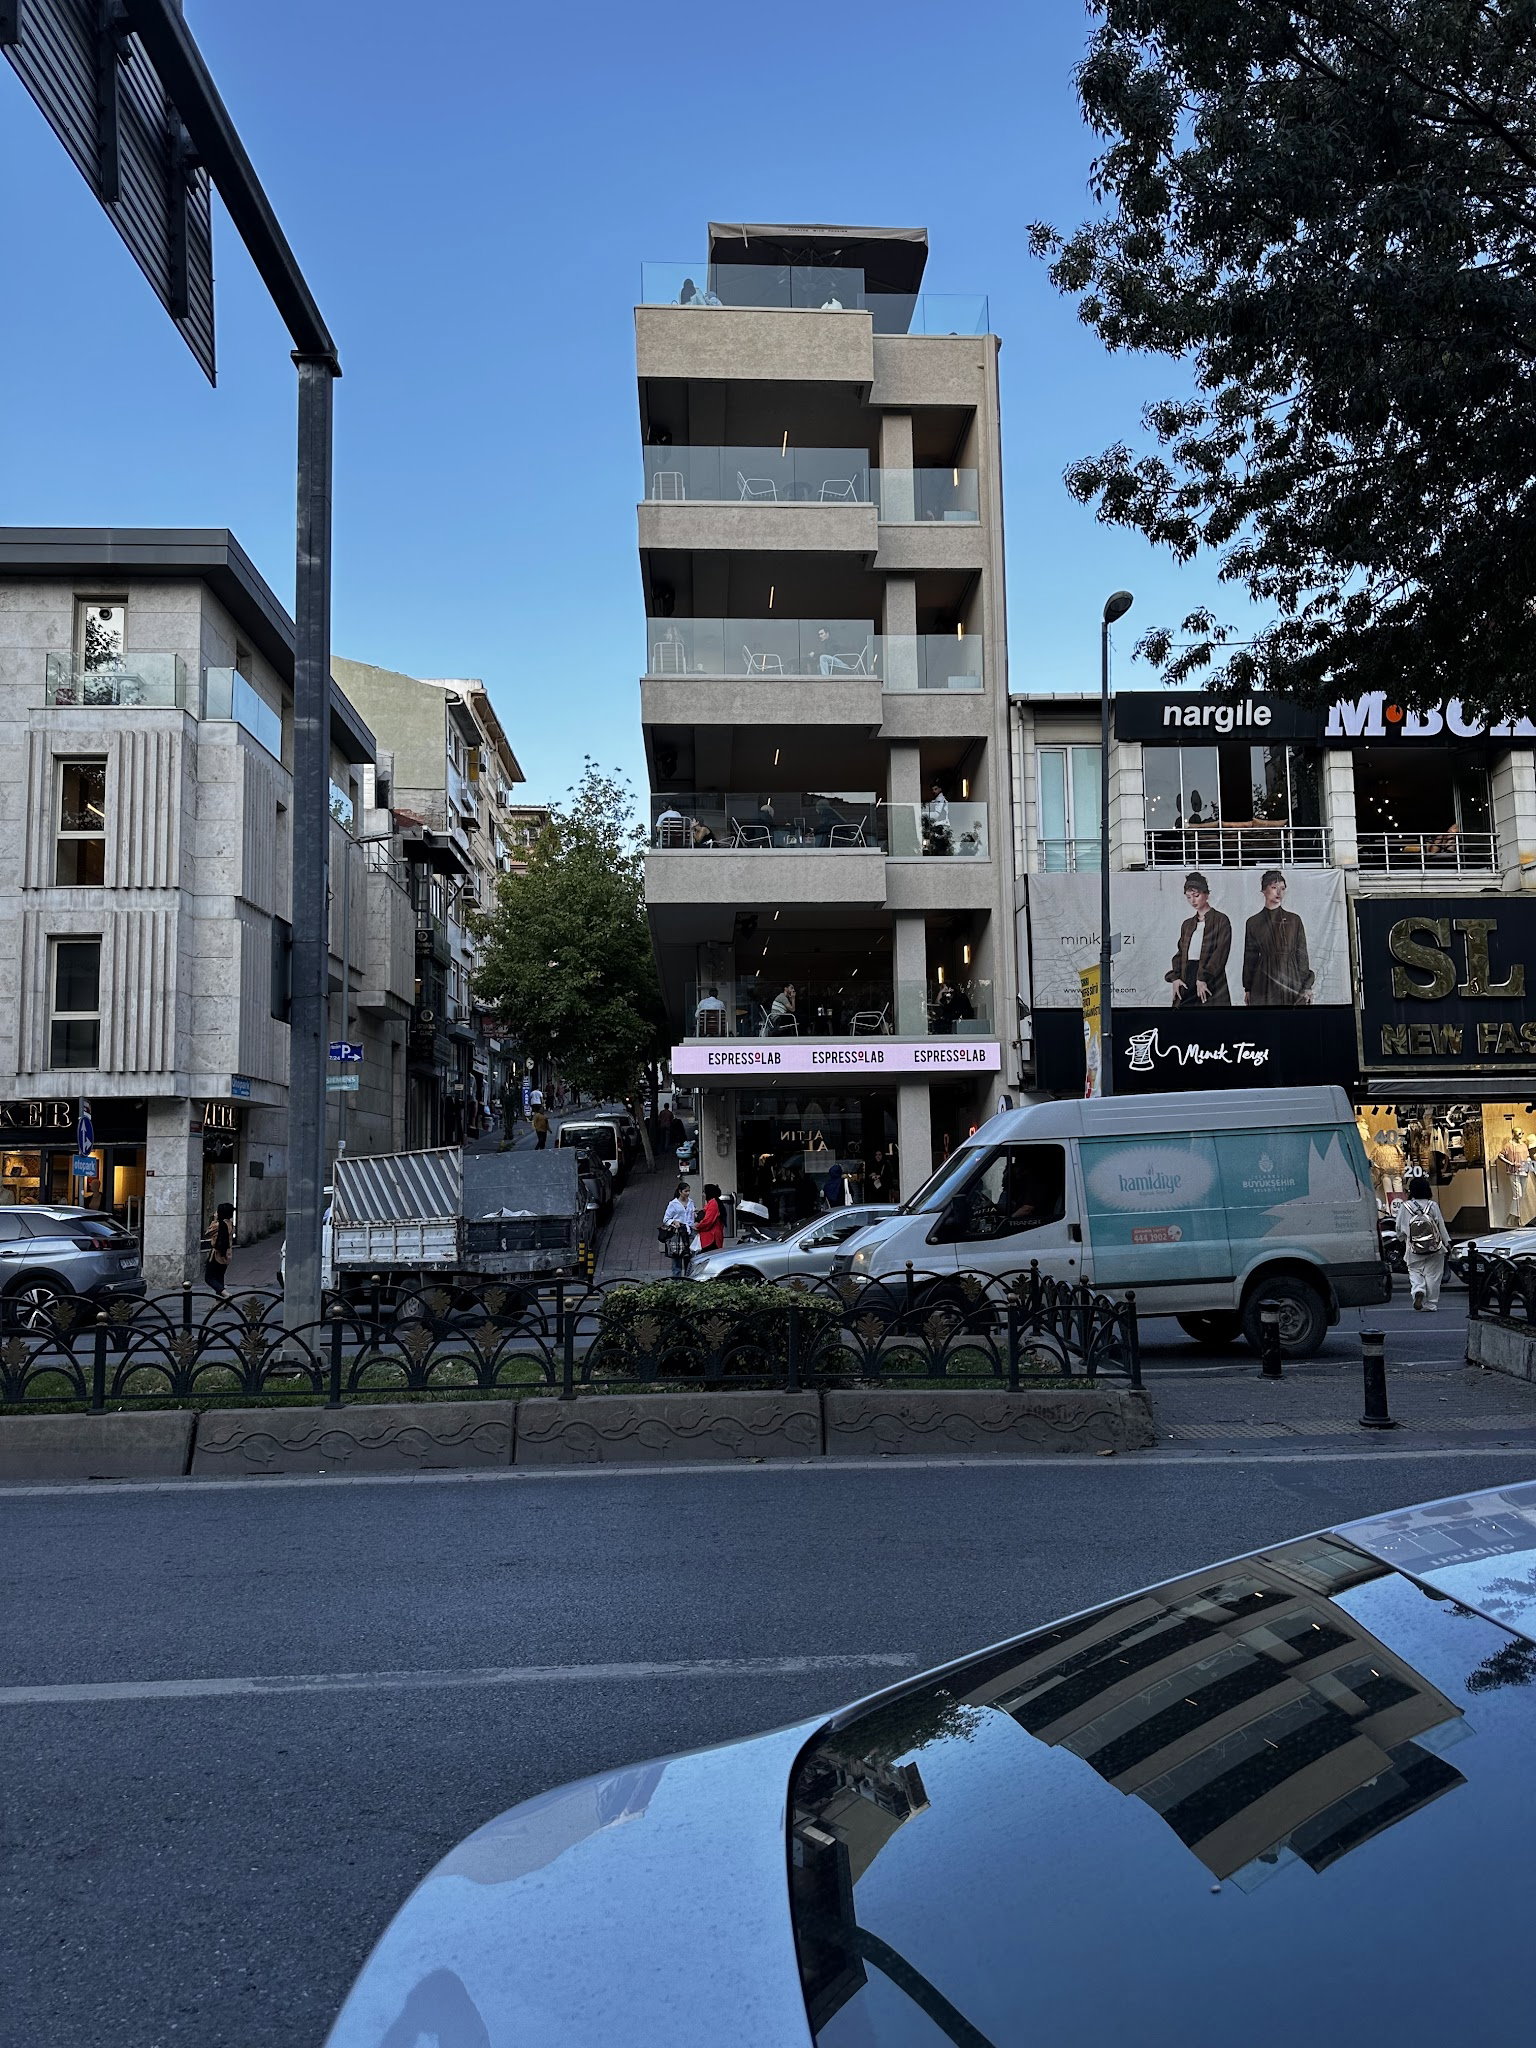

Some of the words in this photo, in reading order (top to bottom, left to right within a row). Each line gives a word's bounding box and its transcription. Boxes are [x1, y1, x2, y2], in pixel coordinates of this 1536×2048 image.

[1163, 698, 1273, 733] nargile
[1388, 916, 1526, 1001] SL
[341, 1044, 352, 1059] P
[1381, 1023, 1464, 1057] NEW
